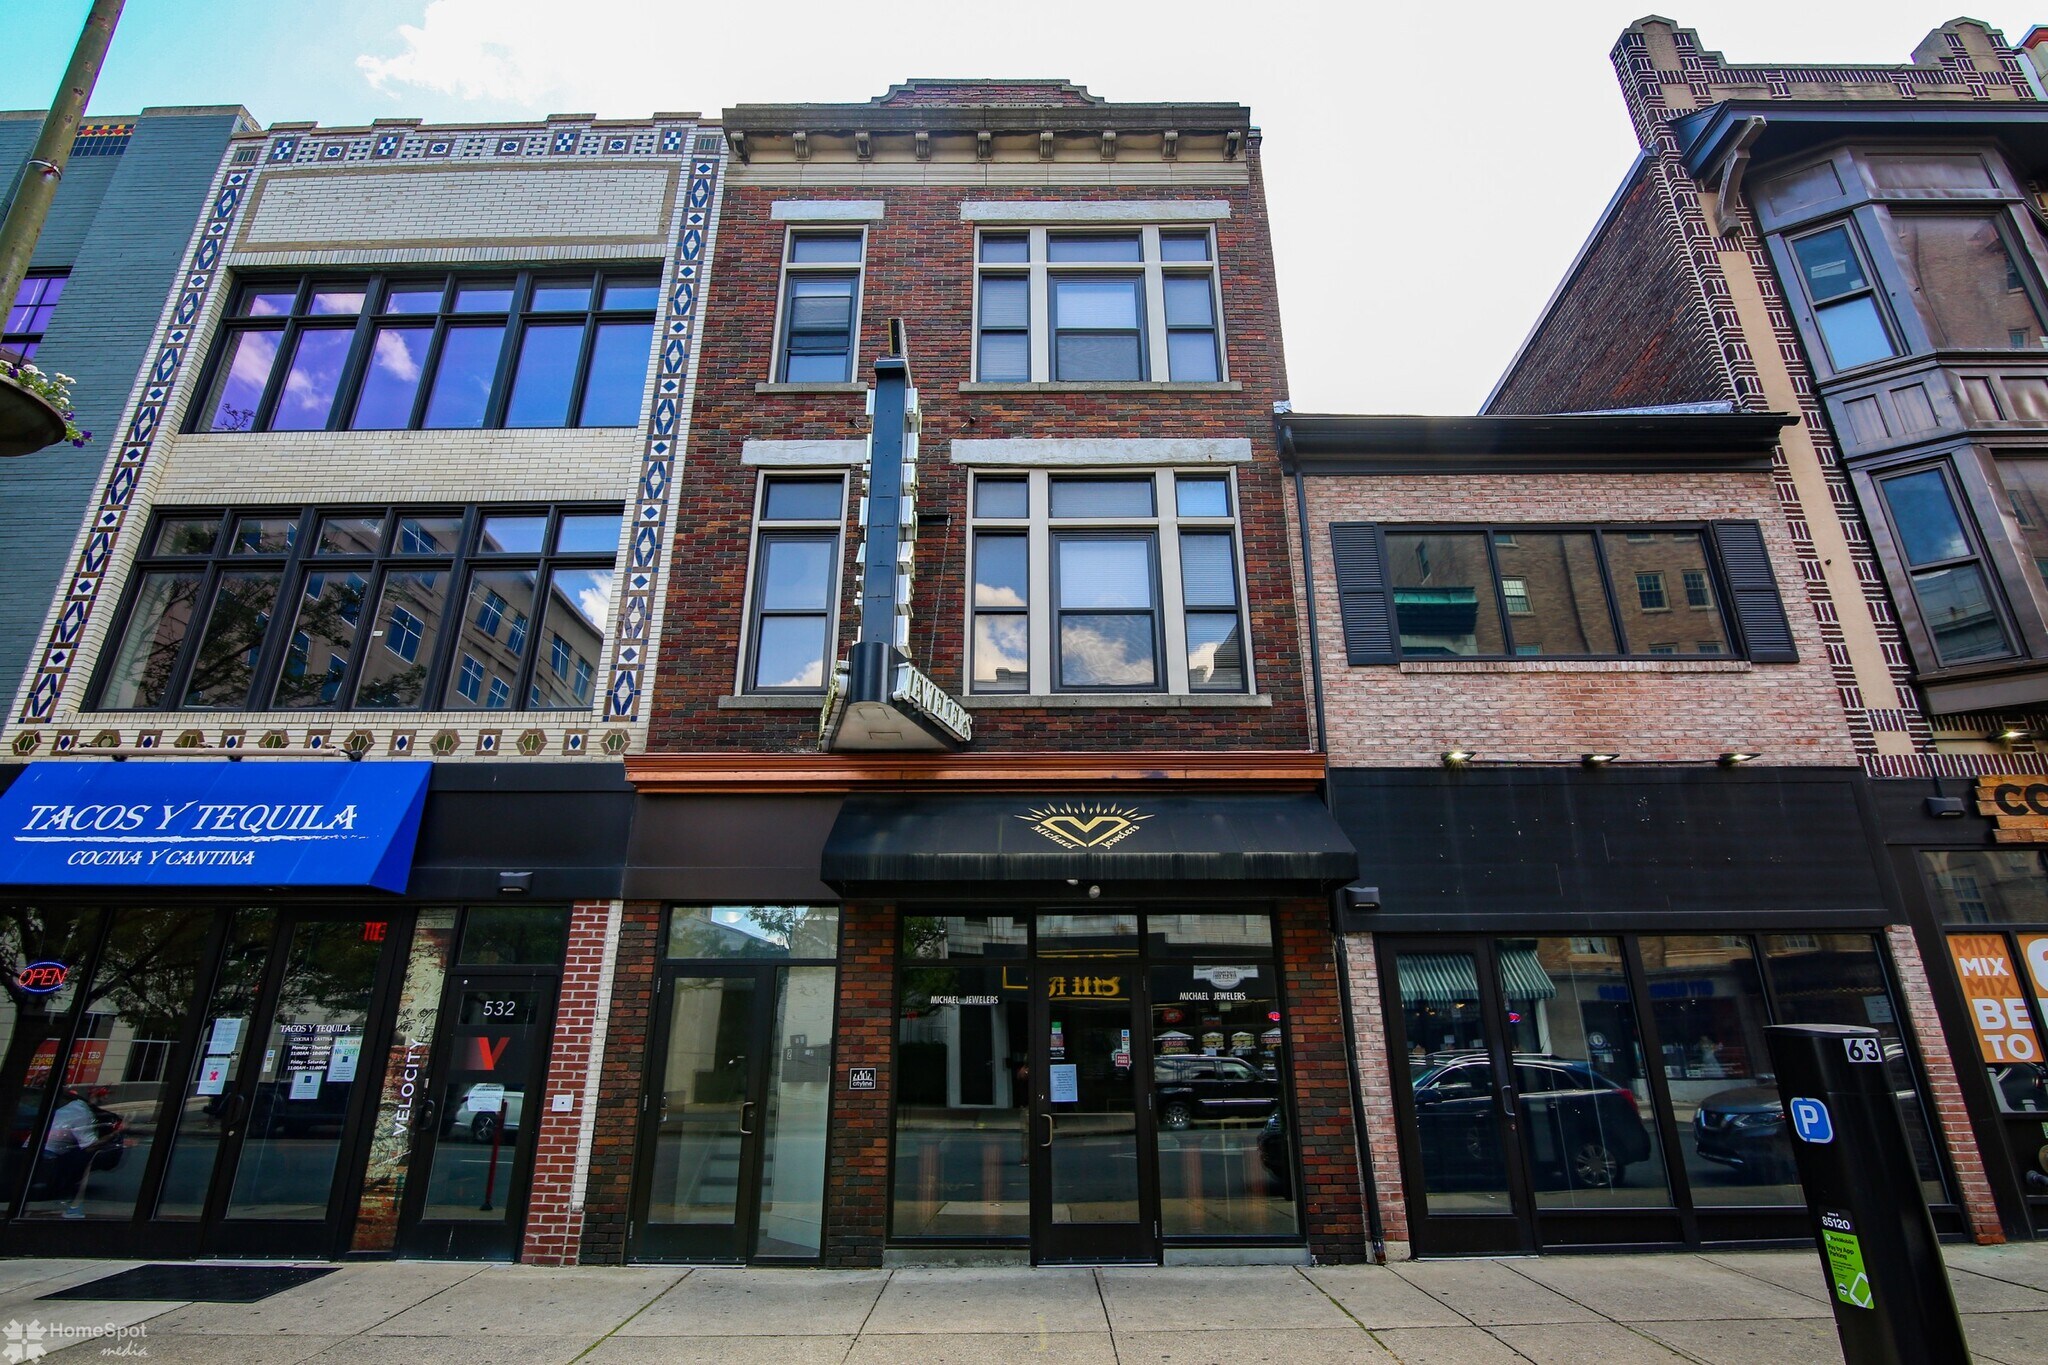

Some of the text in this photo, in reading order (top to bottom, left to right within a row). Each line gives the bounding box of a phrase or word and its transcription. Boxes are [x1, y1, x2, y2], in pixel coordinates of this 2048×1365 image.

[901, 665, 973, 741] JEWELERS
[21, 800, 358, 834] TACOS Y TEQUILA
[1030, 824, 1140, 850] Michael Jewelers
[66, 849, 255, 866] COCINA Y CANTINA
[1953, 938, 2003, 956] MIX
[1958, 957, 2010, 976] MIX
[18, 967, 68, 987] OPEN
[1179, 991, 1246, 1002] MICHAEL JEWELERS
[1965, 977, 2016, 997] MIX
[483, 1000, 516, 1016] 532
[930, 995, 999, 1005] MICHAEL JEWELERS
[280, 1024, 351, 1034] TACOS Y TEQUILA
[1847, 1038, 1881, 1063] 63
[1983, 1034, 2035, 1060] TO
[392, 1038, 426, 1137] VELOCITY
[1822, 1216, 1850, 1230] 85120
